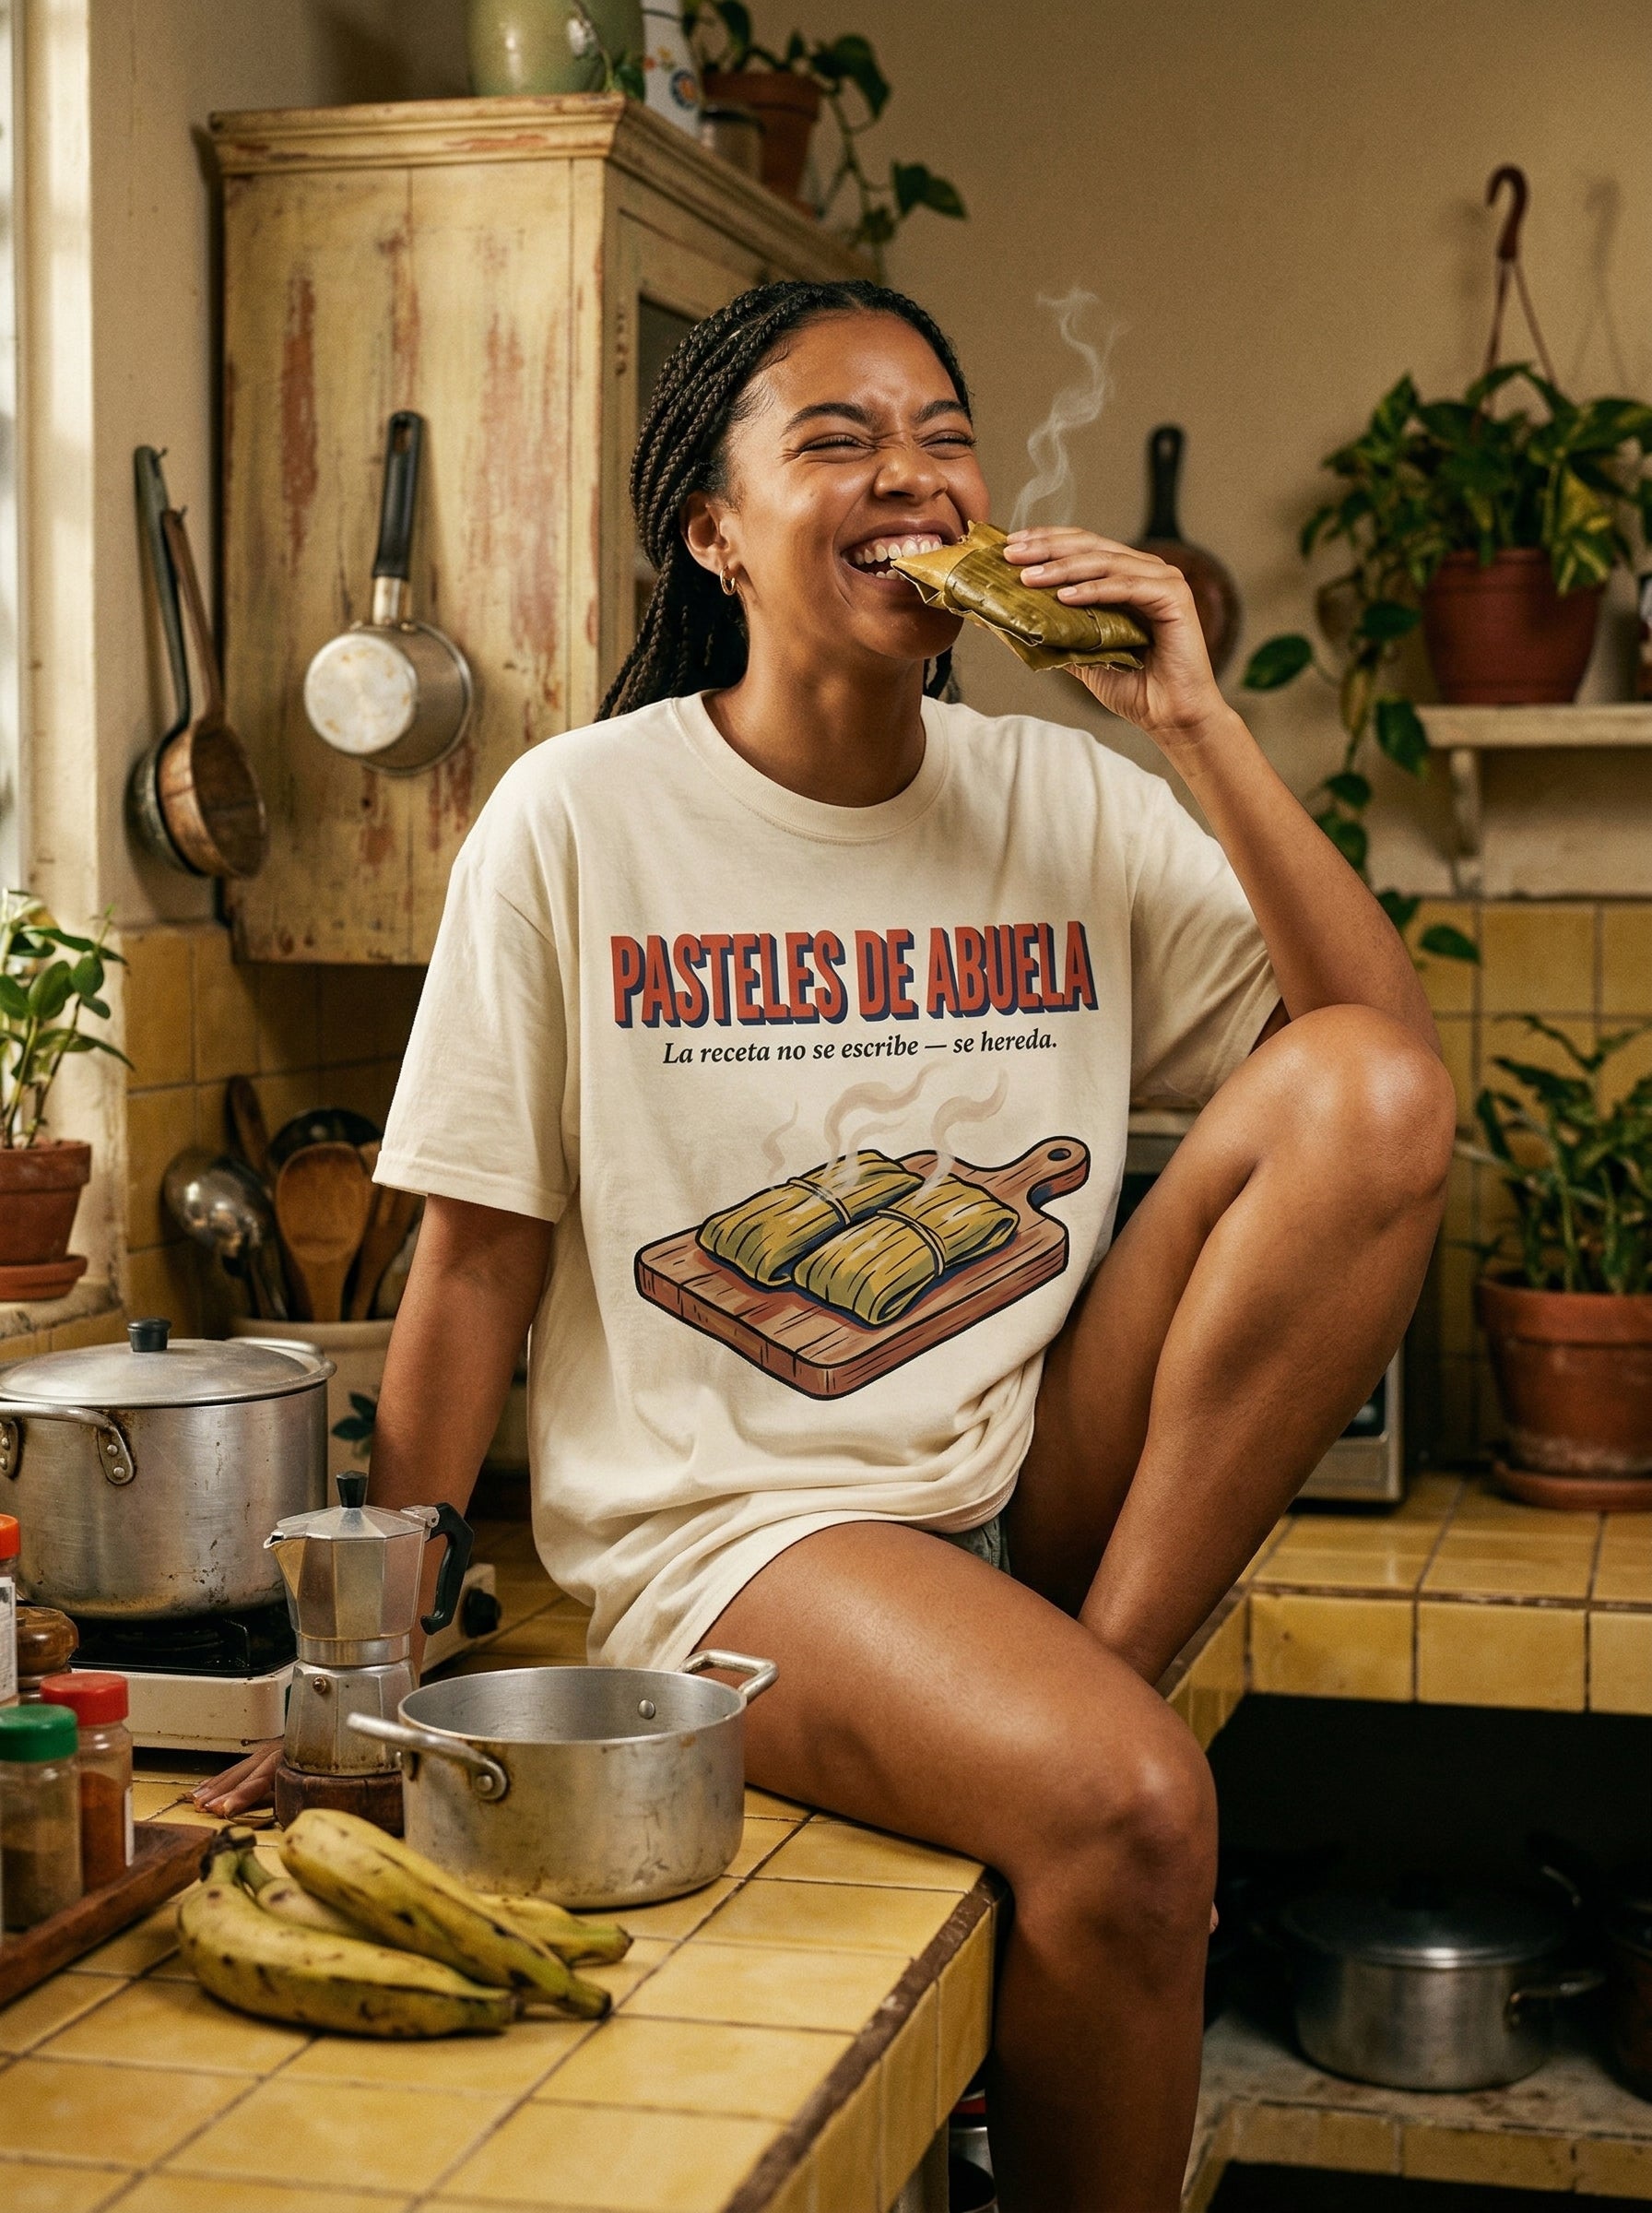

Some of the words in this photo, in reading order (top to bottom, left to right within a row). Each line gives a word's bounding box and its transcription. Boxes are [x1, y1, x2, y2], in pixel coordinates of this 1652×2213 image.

[610, 929, 848, 1028] PASTELES
[855, 929, 919, 1023] DE
[926, 920, 1099, 1020] ABUELA
[662, 1042, 693, 1064] La
[700, 1046, 771, 1064] receta
[776, 1045, 807, 1060] no
[812, 1044, 835, 1059] se
[841, 1034, 919, 1059] escribe
[952, 1037, 974, 1054] se
[980, 1028, 1057, 1052] hereda.
